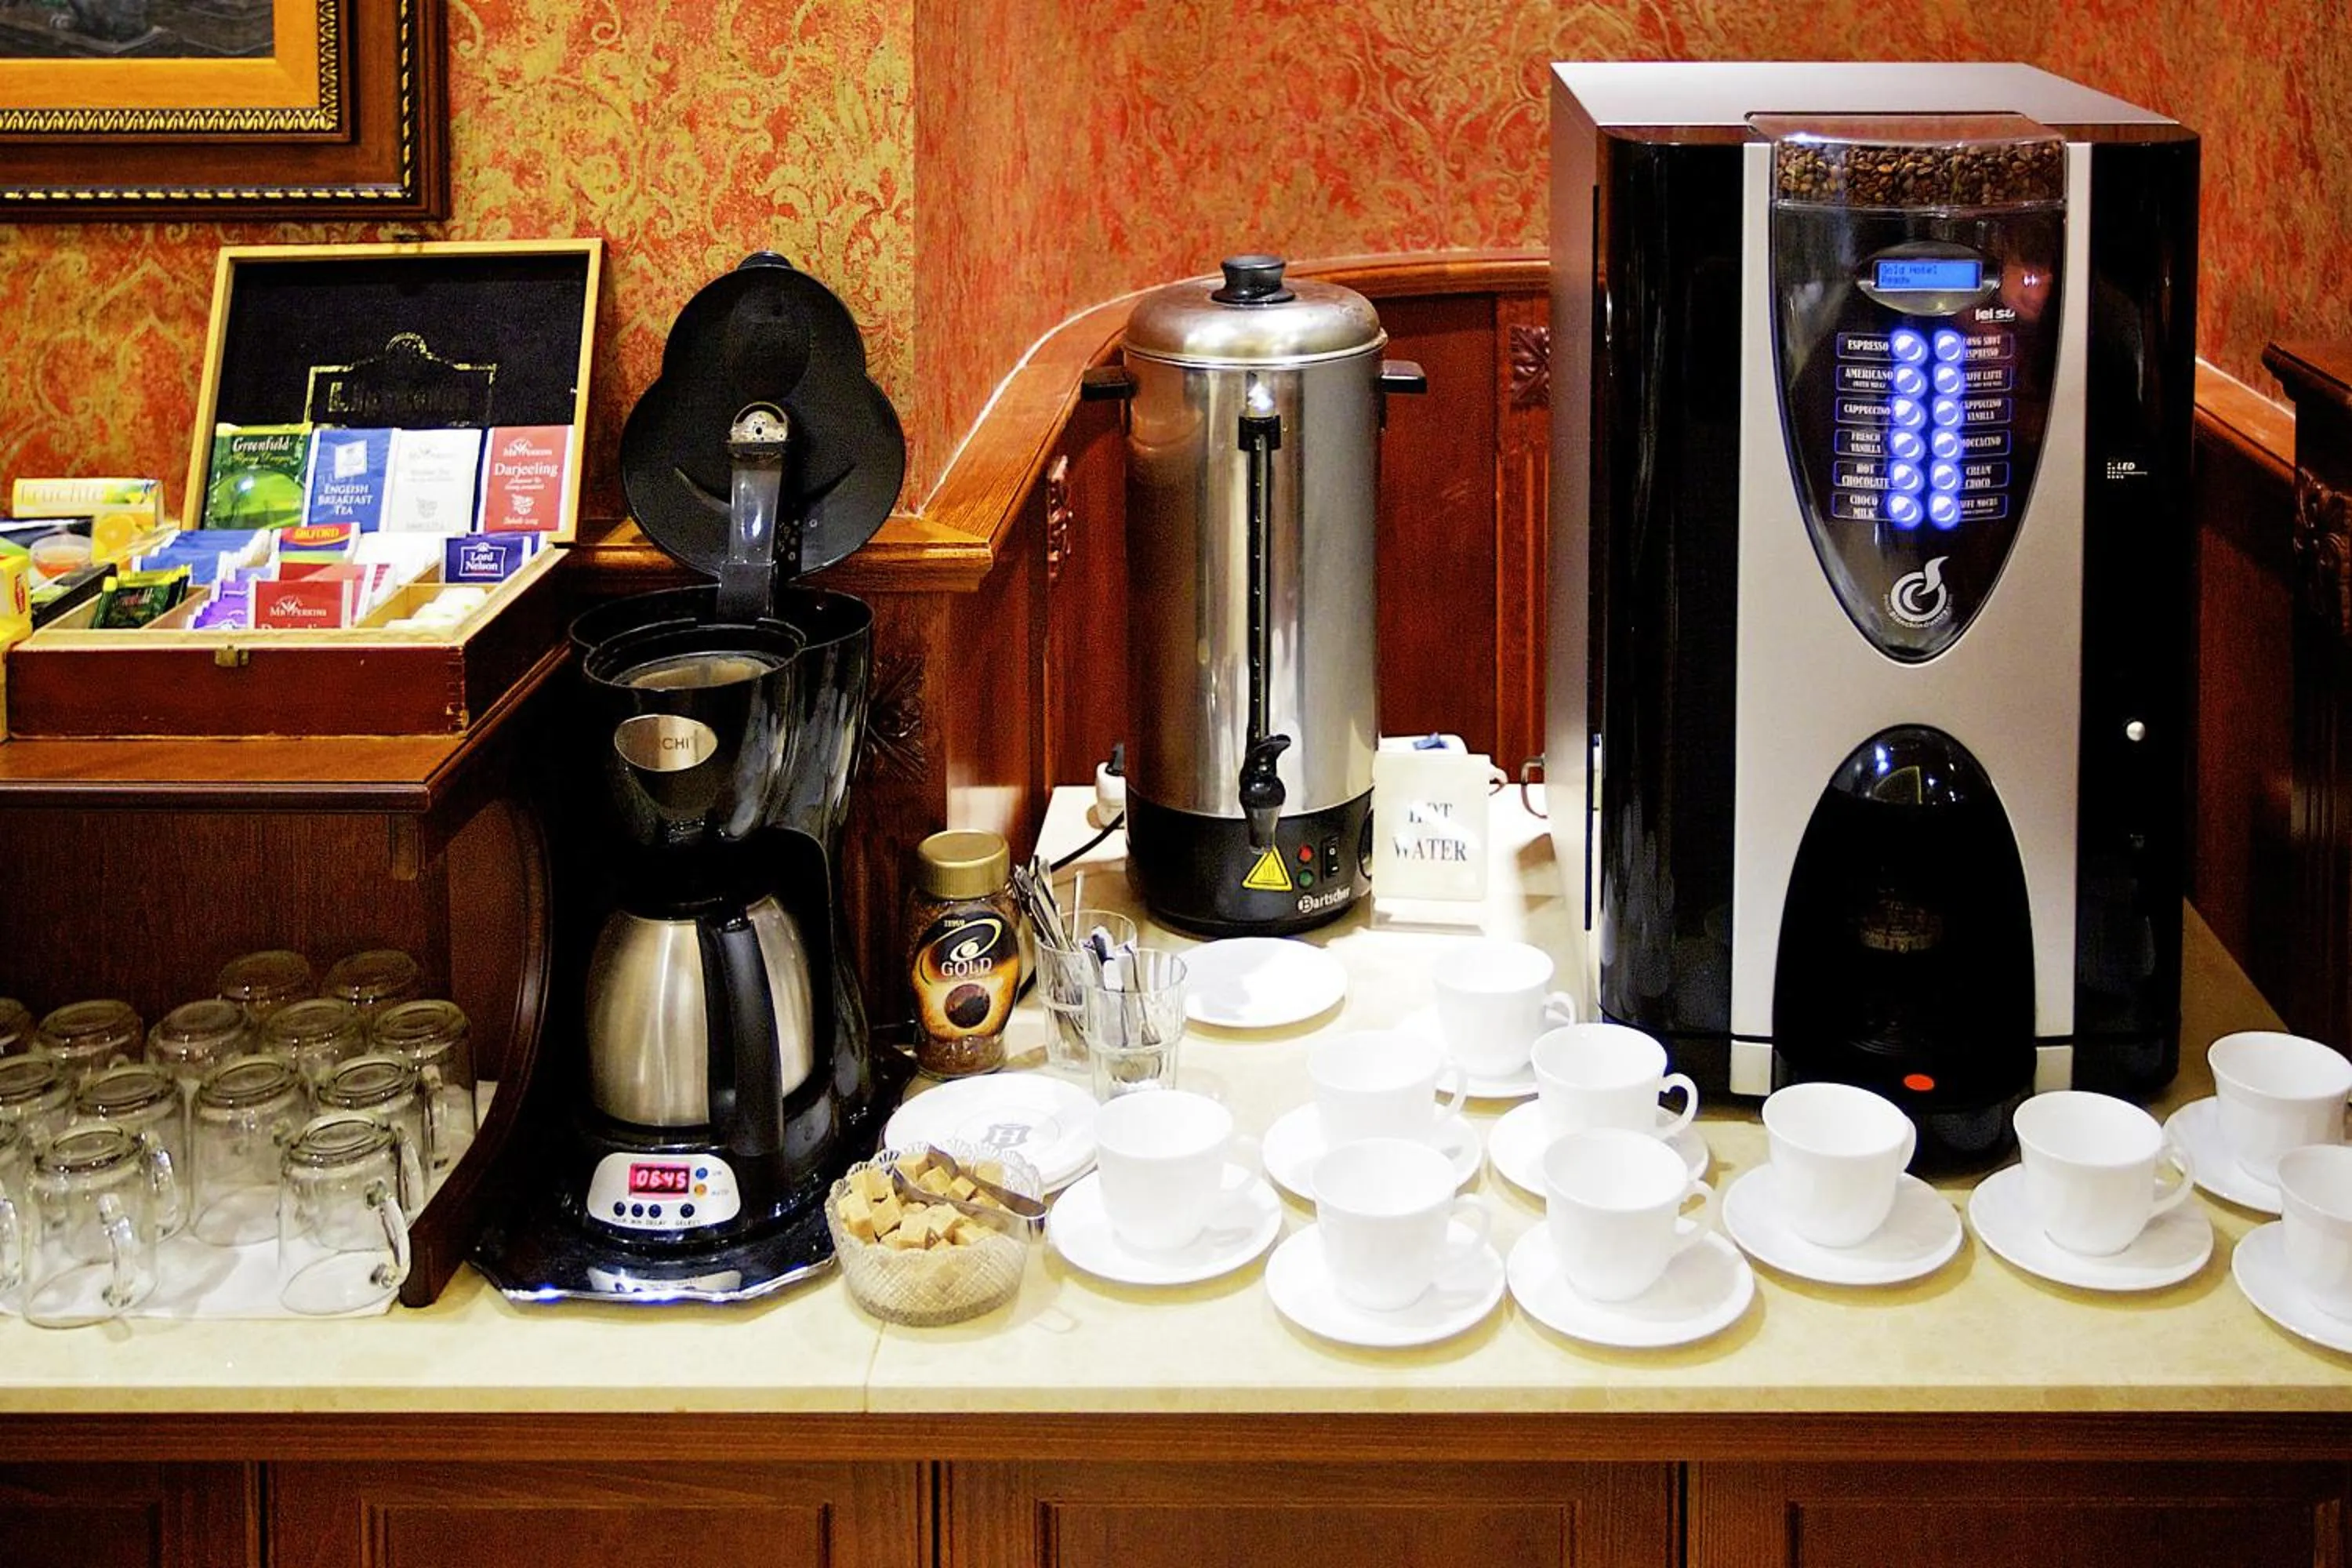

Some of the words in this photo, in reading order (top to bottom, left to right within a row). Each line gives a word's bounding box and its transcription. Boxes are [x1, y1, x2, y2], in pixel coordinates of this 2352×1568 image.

[1847, 339, 1889, 352] ESPRESSO
[1845, 367, 1894, 380] AMERICANO
[1843, 404, 1891, 415] CAPPUCCINO
[233, 436, 290, 453] Greenfield
[494, 462, 559, 477] Darjeeling
[1841, 474, 1890, 488] CHOCOLATE
[323, 483, 370, 494] ENGLISH
[318, 494, 374, 506] BREAKFAST
[334, 505, 354, 515] TEA
[470, 551, 494, 561] Lord
[465, 561, 499, 572] Nelson
[1393, 837, 1467, 862] WATER
[1298, 887, 1352, 913] Bartscher
[941, 957, 992, 977] GOLD
